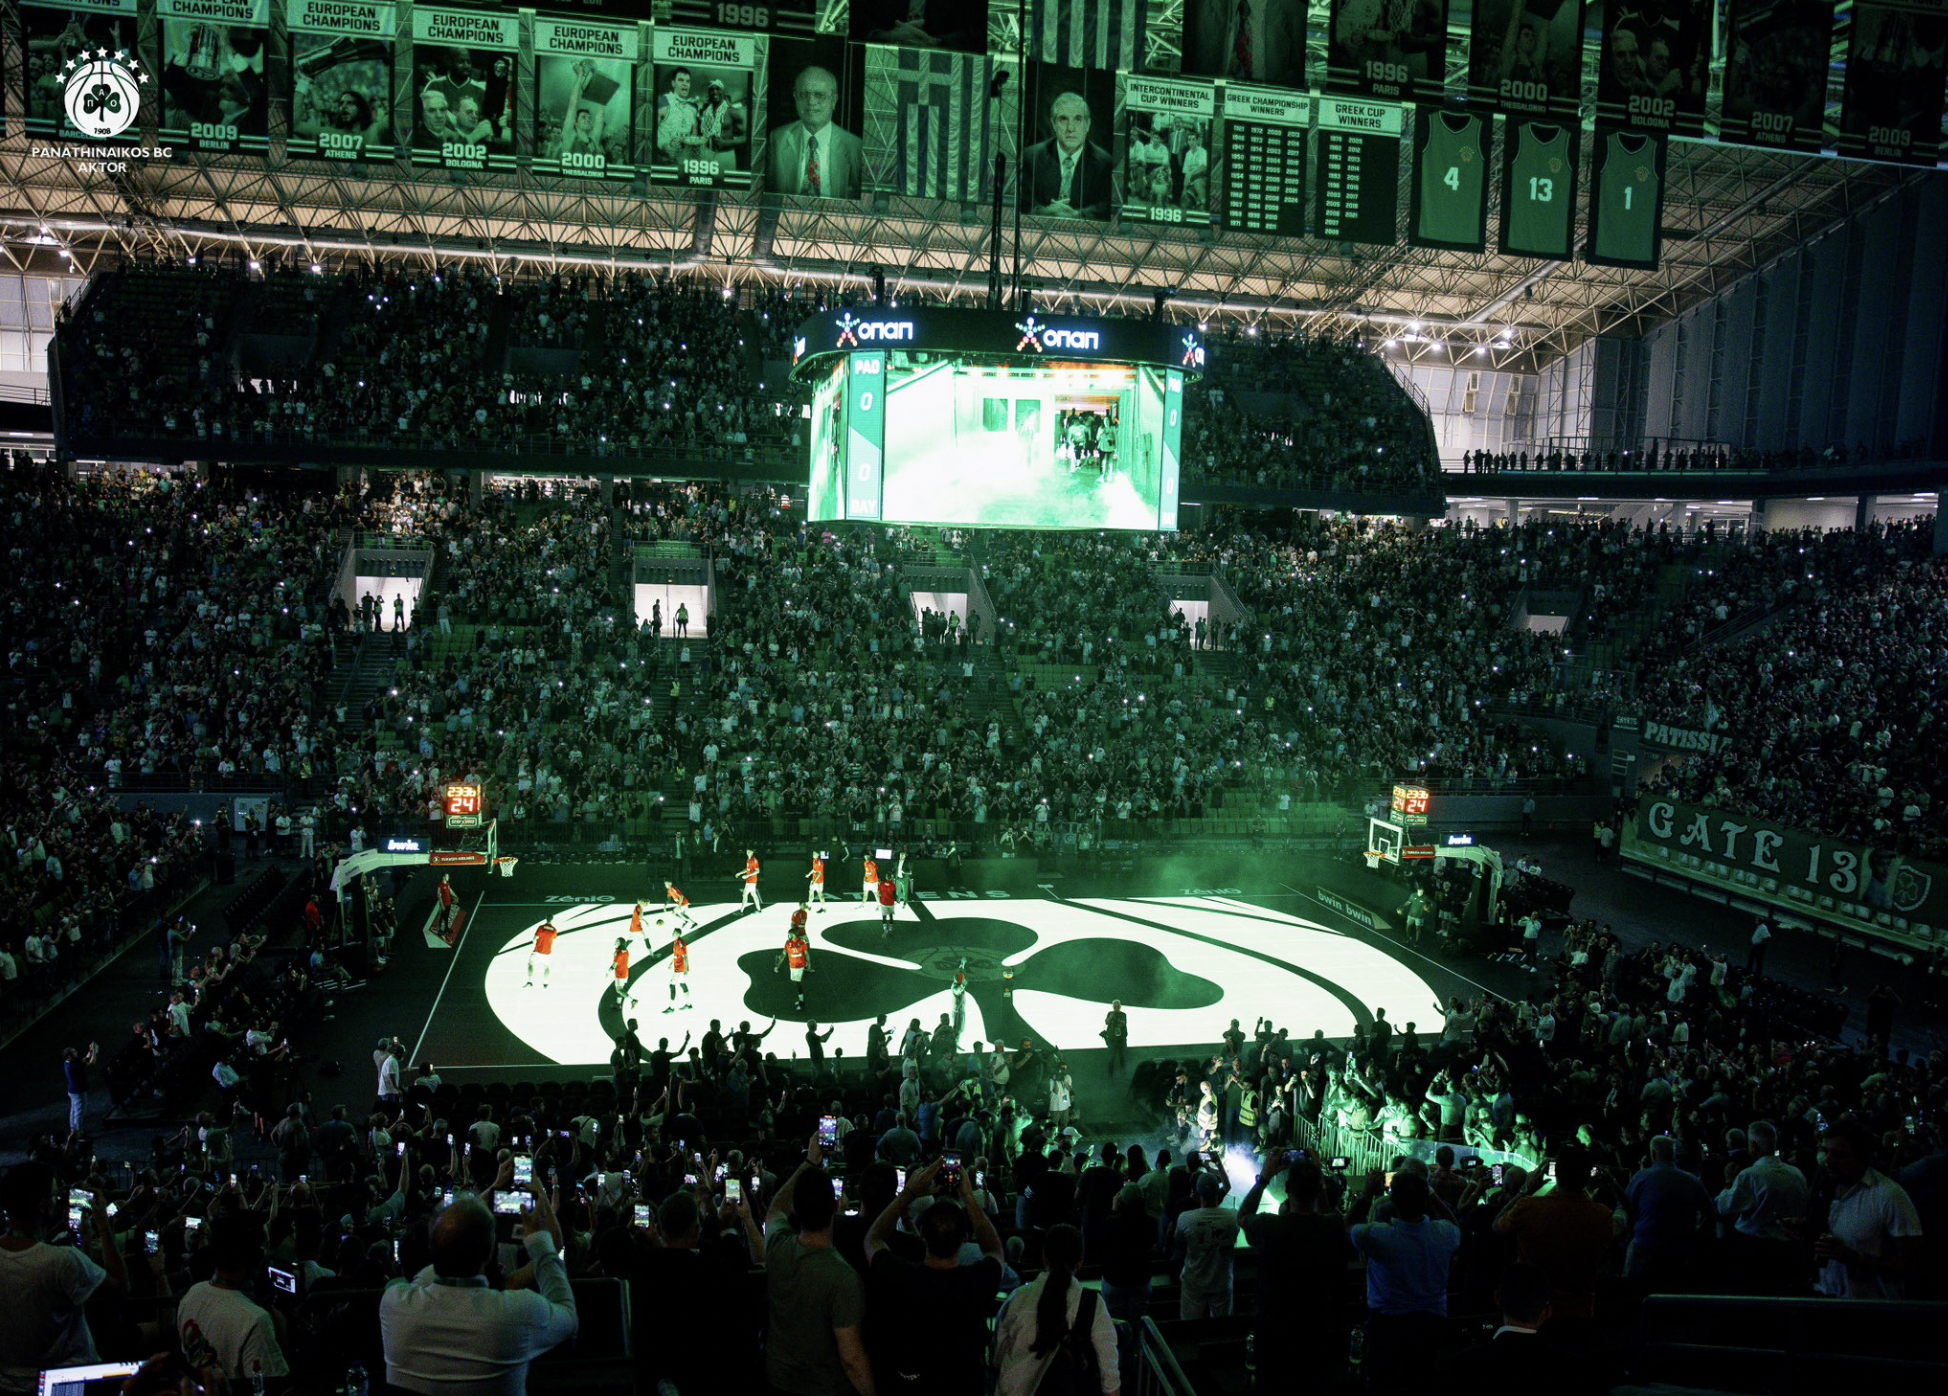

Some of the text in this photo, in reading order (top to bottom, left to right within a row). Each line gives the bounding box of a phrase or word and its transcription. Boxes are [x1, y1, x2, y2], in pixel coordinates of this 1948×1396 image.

[173, 0, 253, 19] CHAMPIONS
[308, 2, 376, 19] EUROPEAN
[716, 2, 768, 28] 1996
[303, 15, 381, 32] CHAMPIONS
[432, 14, 500, 31] EUROPEAN
[427, 27, 504, 44] CHAMPIONS
[553, 26, 620, 43] EUROPEAN
[672, 35, 736, 51] EUROPEAN
[549, 37, 623, 55] CHAMPIONS
[667, 46, 740, 63] CHAMPIONS
[1365, 60, 1409, 84] 1996
[1129, 83, 1211, 101] INTERCONTINENTAL
[1373, 83, 1400, 97] PARIS
[1500, 79, 1548, 102] 2000
[1140, 94, 1199, 109] CUP WINNERS
[1226, 94, 1309, 111] GREEK CHAMPIONSHIP
[1628, 94, 1675, 118] 2002
[1249, 105, 1286, 116] WINNERS
[1335, 104, 1386, 118] GREEK CUP
[1338, 115, 1382, 129] WINNERS
[1630, 115, 1671, 130] BOLOGNA
[1750, 111, 1794, 133] 2007
[190, 122, 238, 140] 2009
[1755, 131, 1787, 144] ATHENS
[199, 139, 231, 150] BERLIN
[318, 132, 363, 150] 2007
[324, 148, 358, 159] ATHENS
[442, 142, 487, 160] 2002
[445, 159, 483, 169] BOLOGNA
[562, 152, 605, 169] 2000
[683, 159, 720, 176] 1996
[689, 175, 713, 186] PARIS
[1443, 166, 1460, 191] 4
[1529, 177, 1553, 202] 13
[1624, 186, 1633, 210] 1
[1150, 207, 1182, 222] 1996
[854, 359, 880, 375] PAO
[860, 392, 873, 411] 0
[450, 797, 474, 812] 24
[1407, 799, 1426, 812] 24
[1649, 801, 1859, 893] GATE 13
